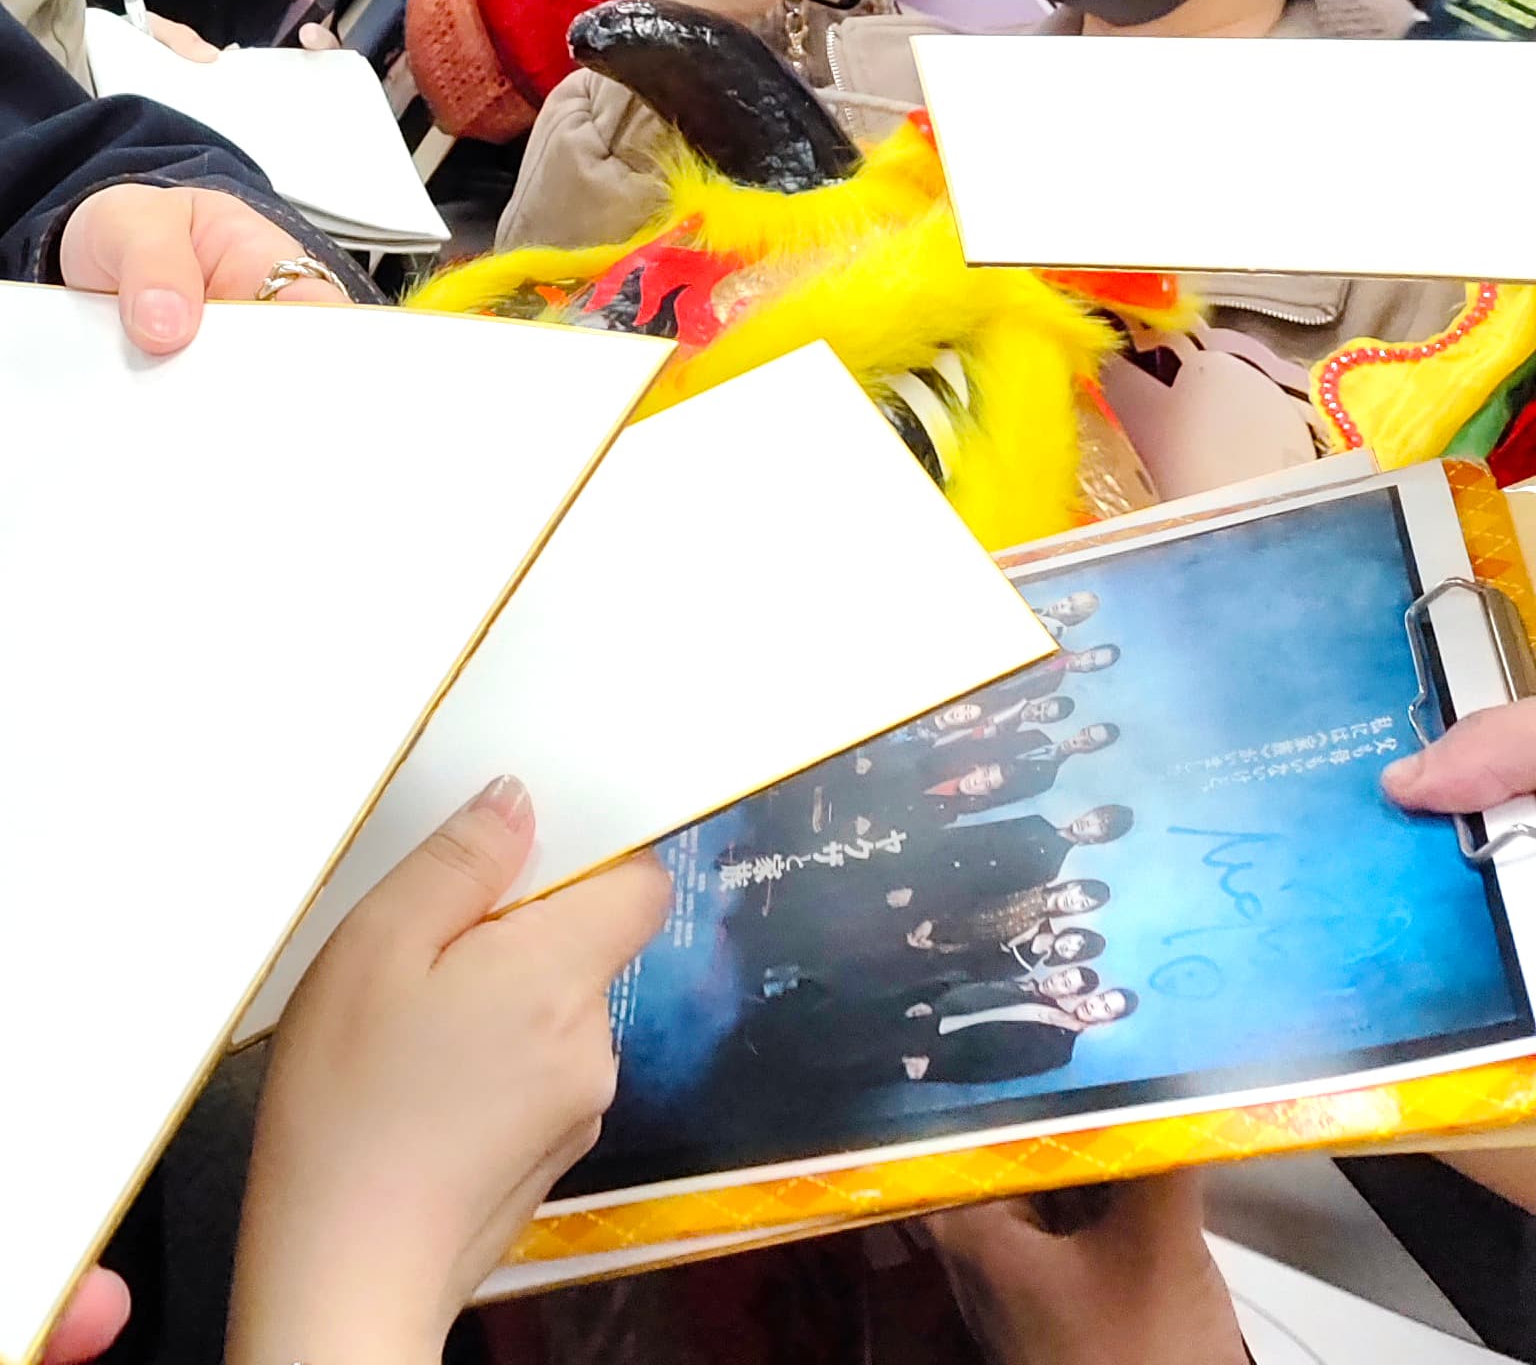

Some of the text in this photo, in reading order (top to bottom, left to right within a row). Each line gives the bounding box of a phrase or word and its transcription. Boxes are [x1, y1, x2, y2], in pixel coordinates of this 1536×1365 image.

[719, 828, 908, 893] ヤクザと家族
